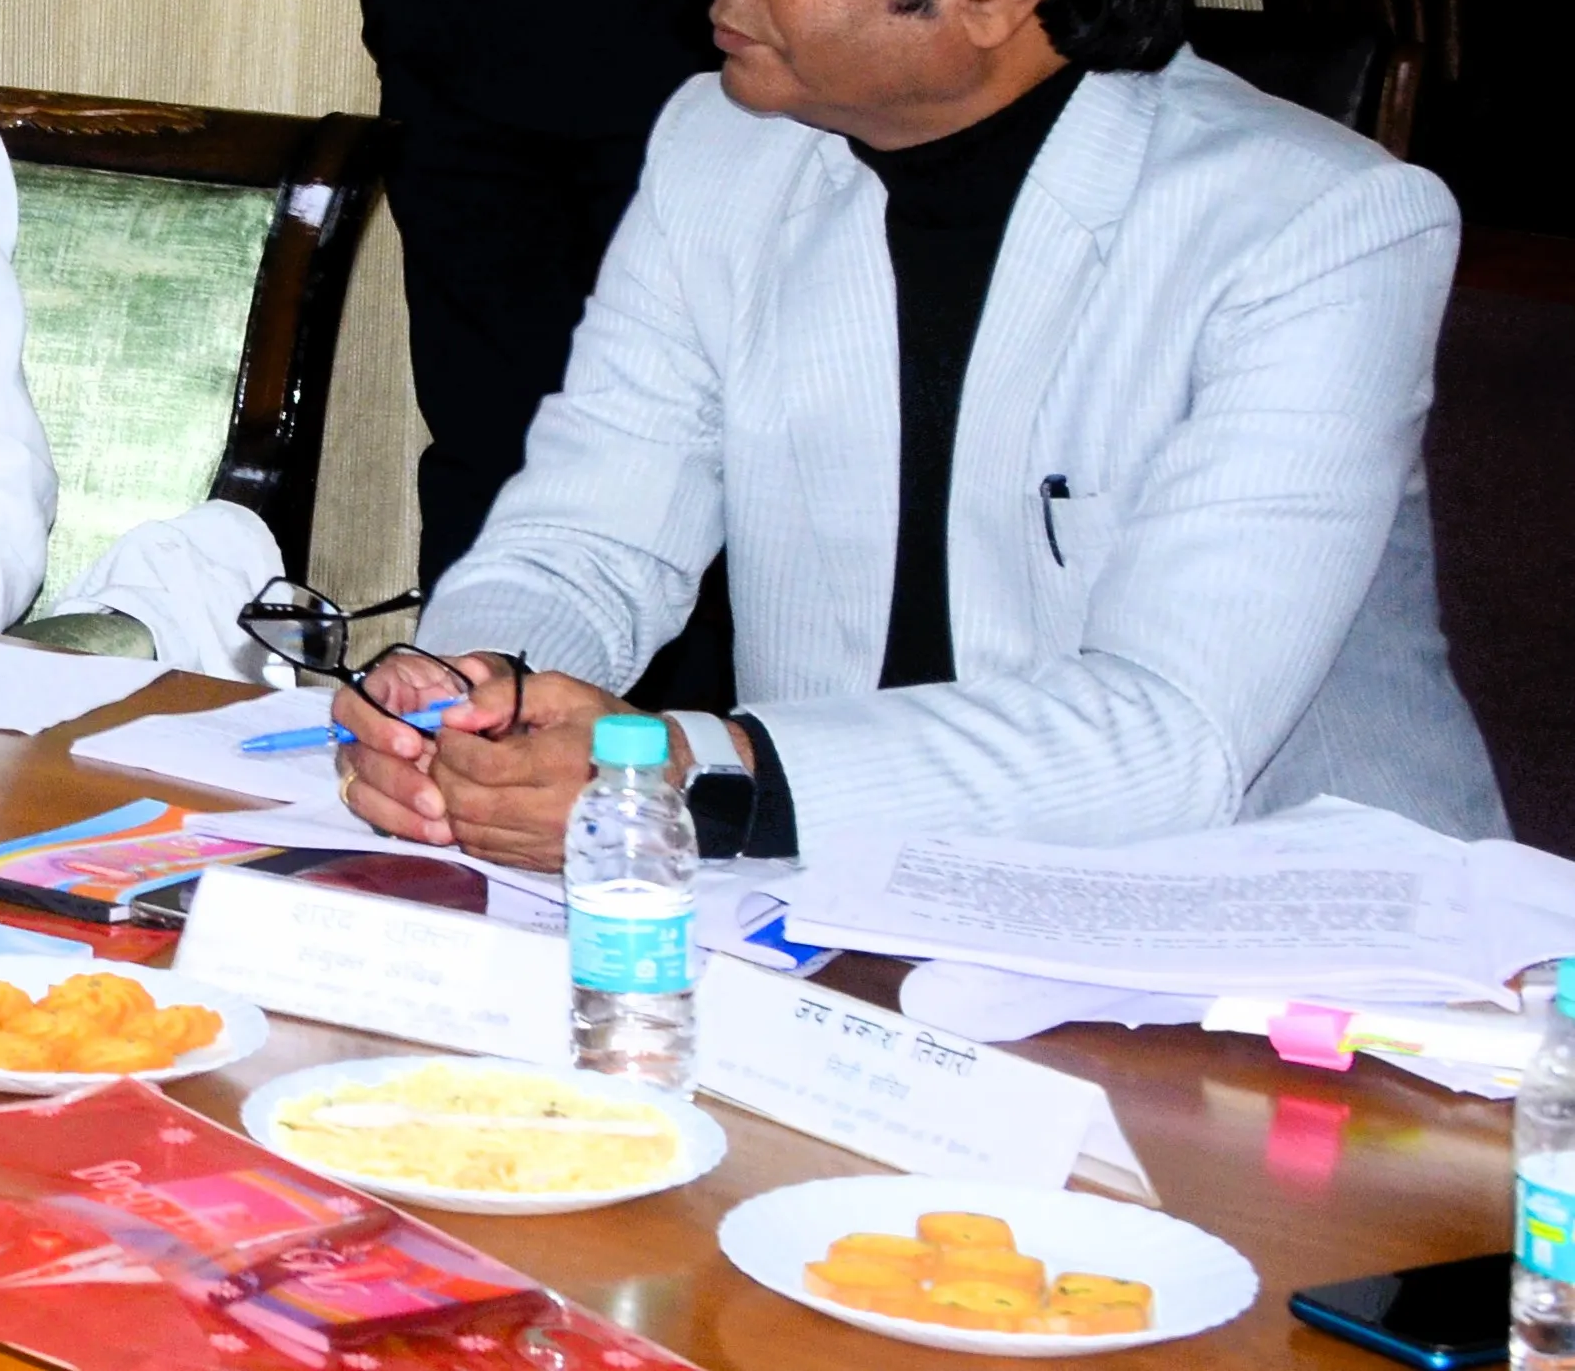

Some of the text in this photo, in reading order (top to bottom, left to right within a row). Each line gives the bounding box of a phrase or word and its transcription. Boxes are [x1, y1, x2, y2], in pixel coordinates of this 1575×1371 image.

[795, 998, 978, 1076] जय प्रकाश तिवारी
